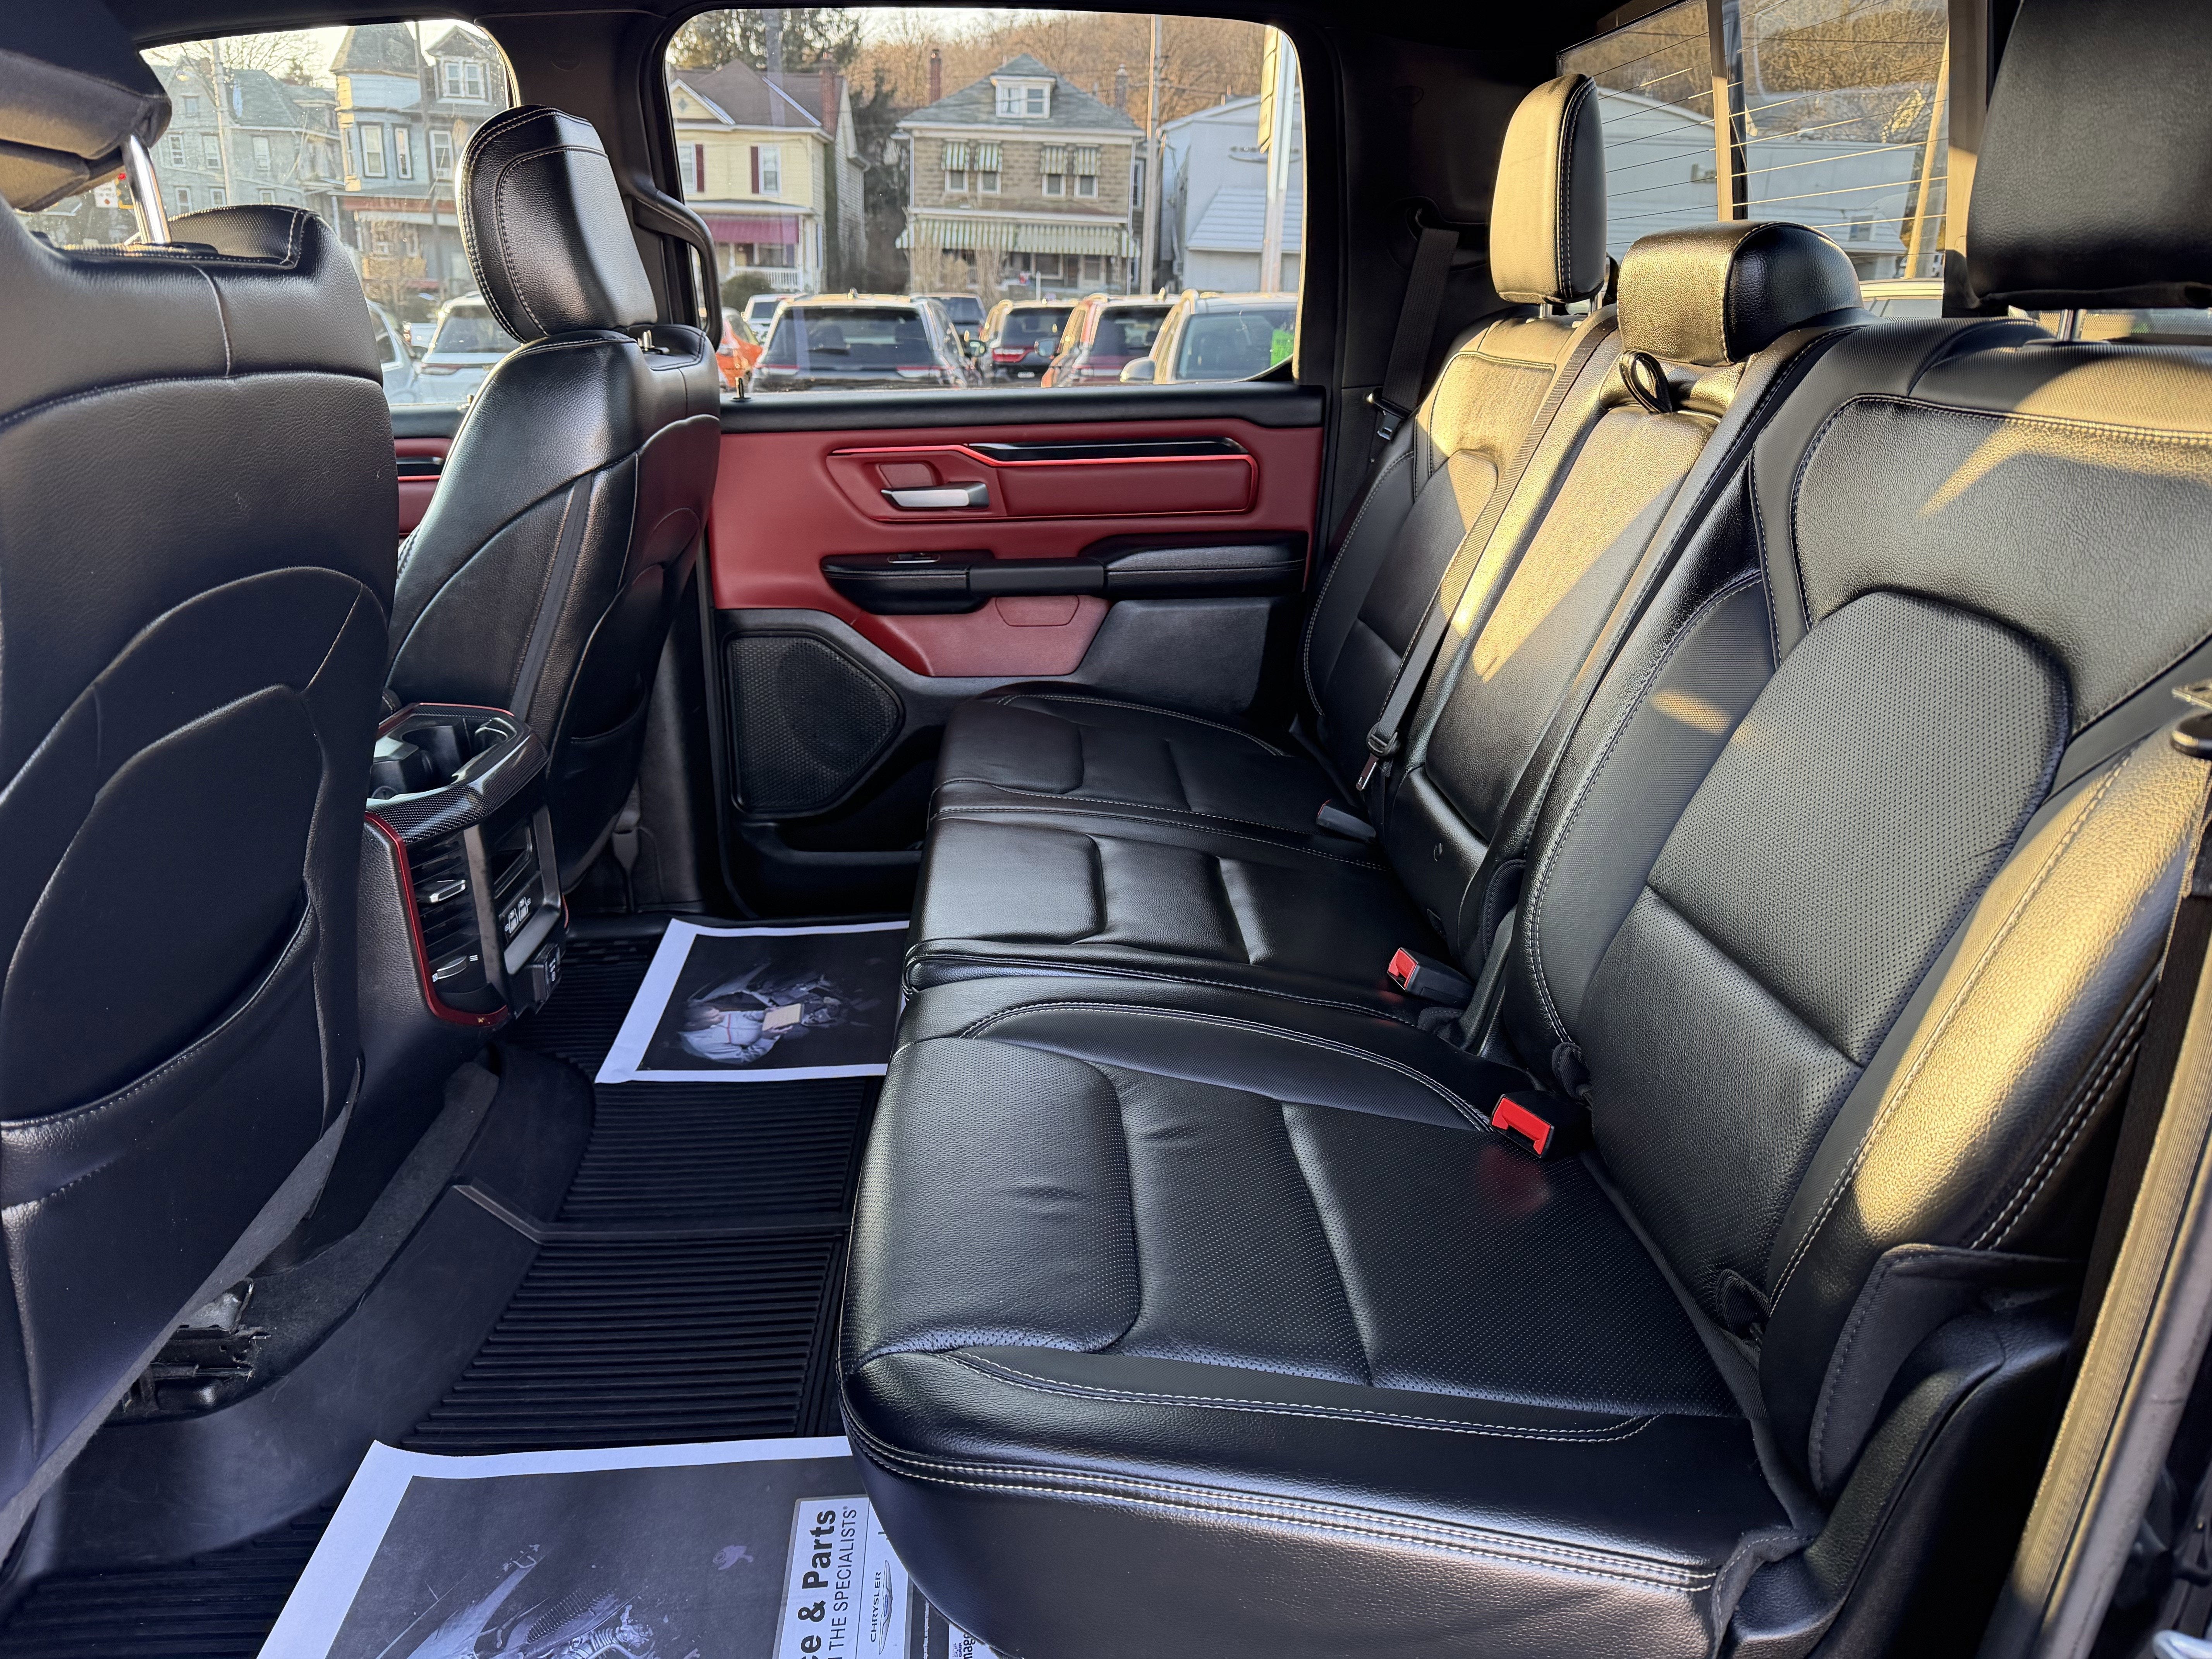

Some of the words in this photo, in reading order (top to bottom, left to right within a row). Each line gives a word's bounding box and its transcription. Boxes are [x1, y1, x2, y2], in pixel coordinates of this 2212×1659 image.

[801, 1510, 836, 1589] Parts
[798, 1600, 826, 1623] &
[828, 1616, 847, 1651] THE
[870, 1571, 881, 1643] CHRYSLER
